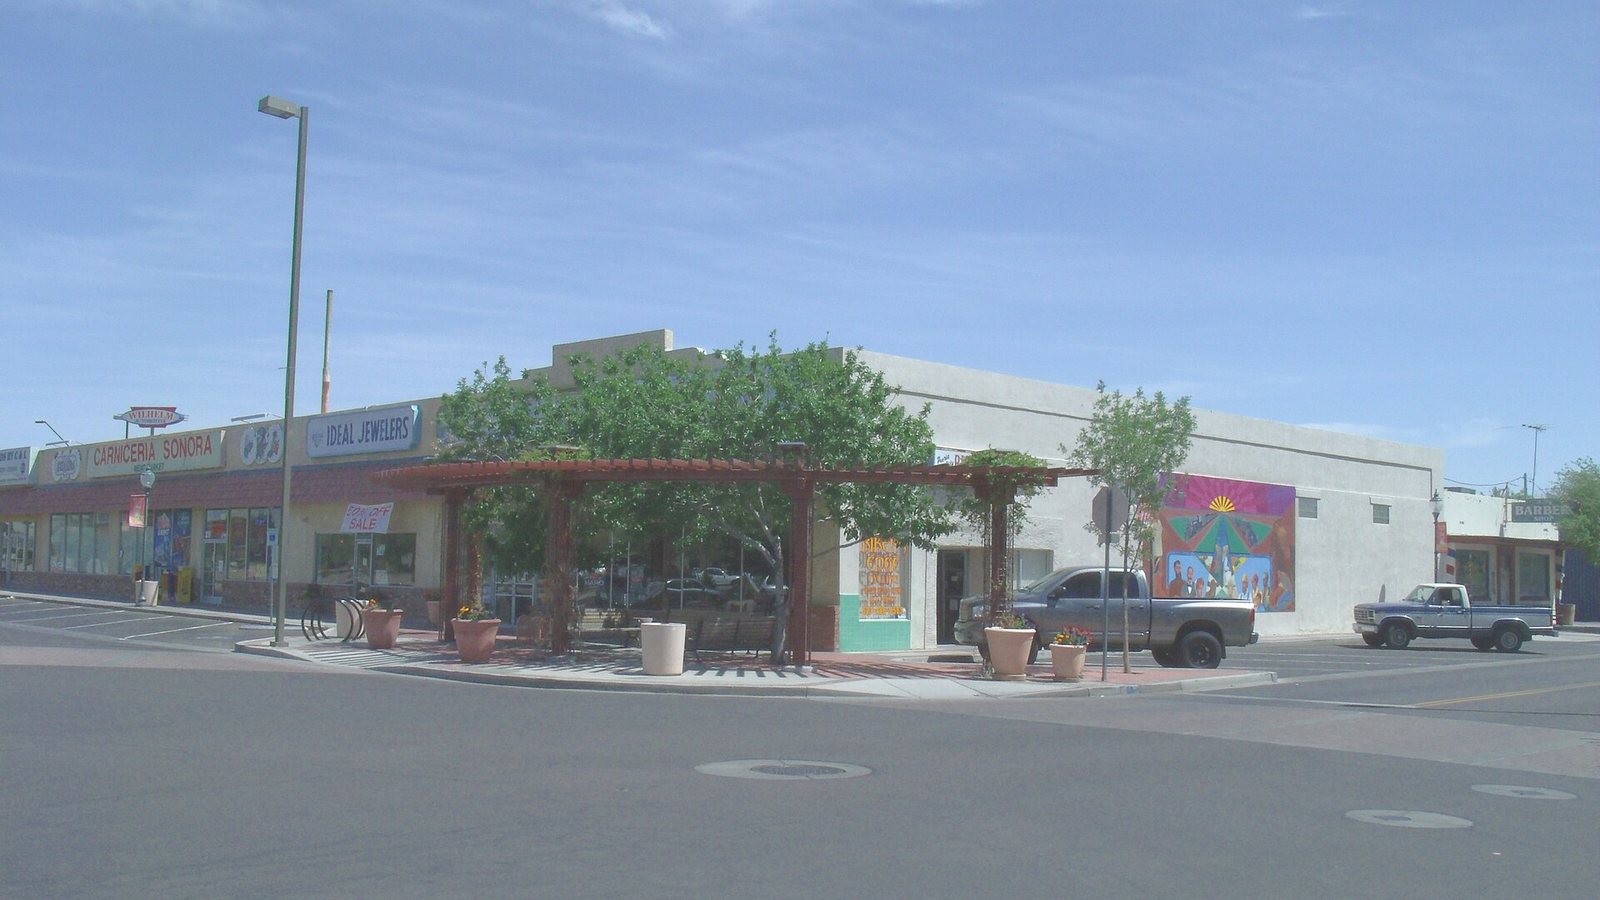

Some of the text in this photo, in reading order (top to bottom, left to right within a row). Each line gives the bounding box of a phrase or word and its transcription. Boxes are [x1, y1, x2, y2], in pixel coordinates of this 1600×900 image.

[128, 410, 174, 420] WILHELM
[326, 416, 409, 447] IDEAL JEWELERS
[94, 435, 213, 467] CARNICERIA SONORA
[350, 518, 377, 530] SALE
